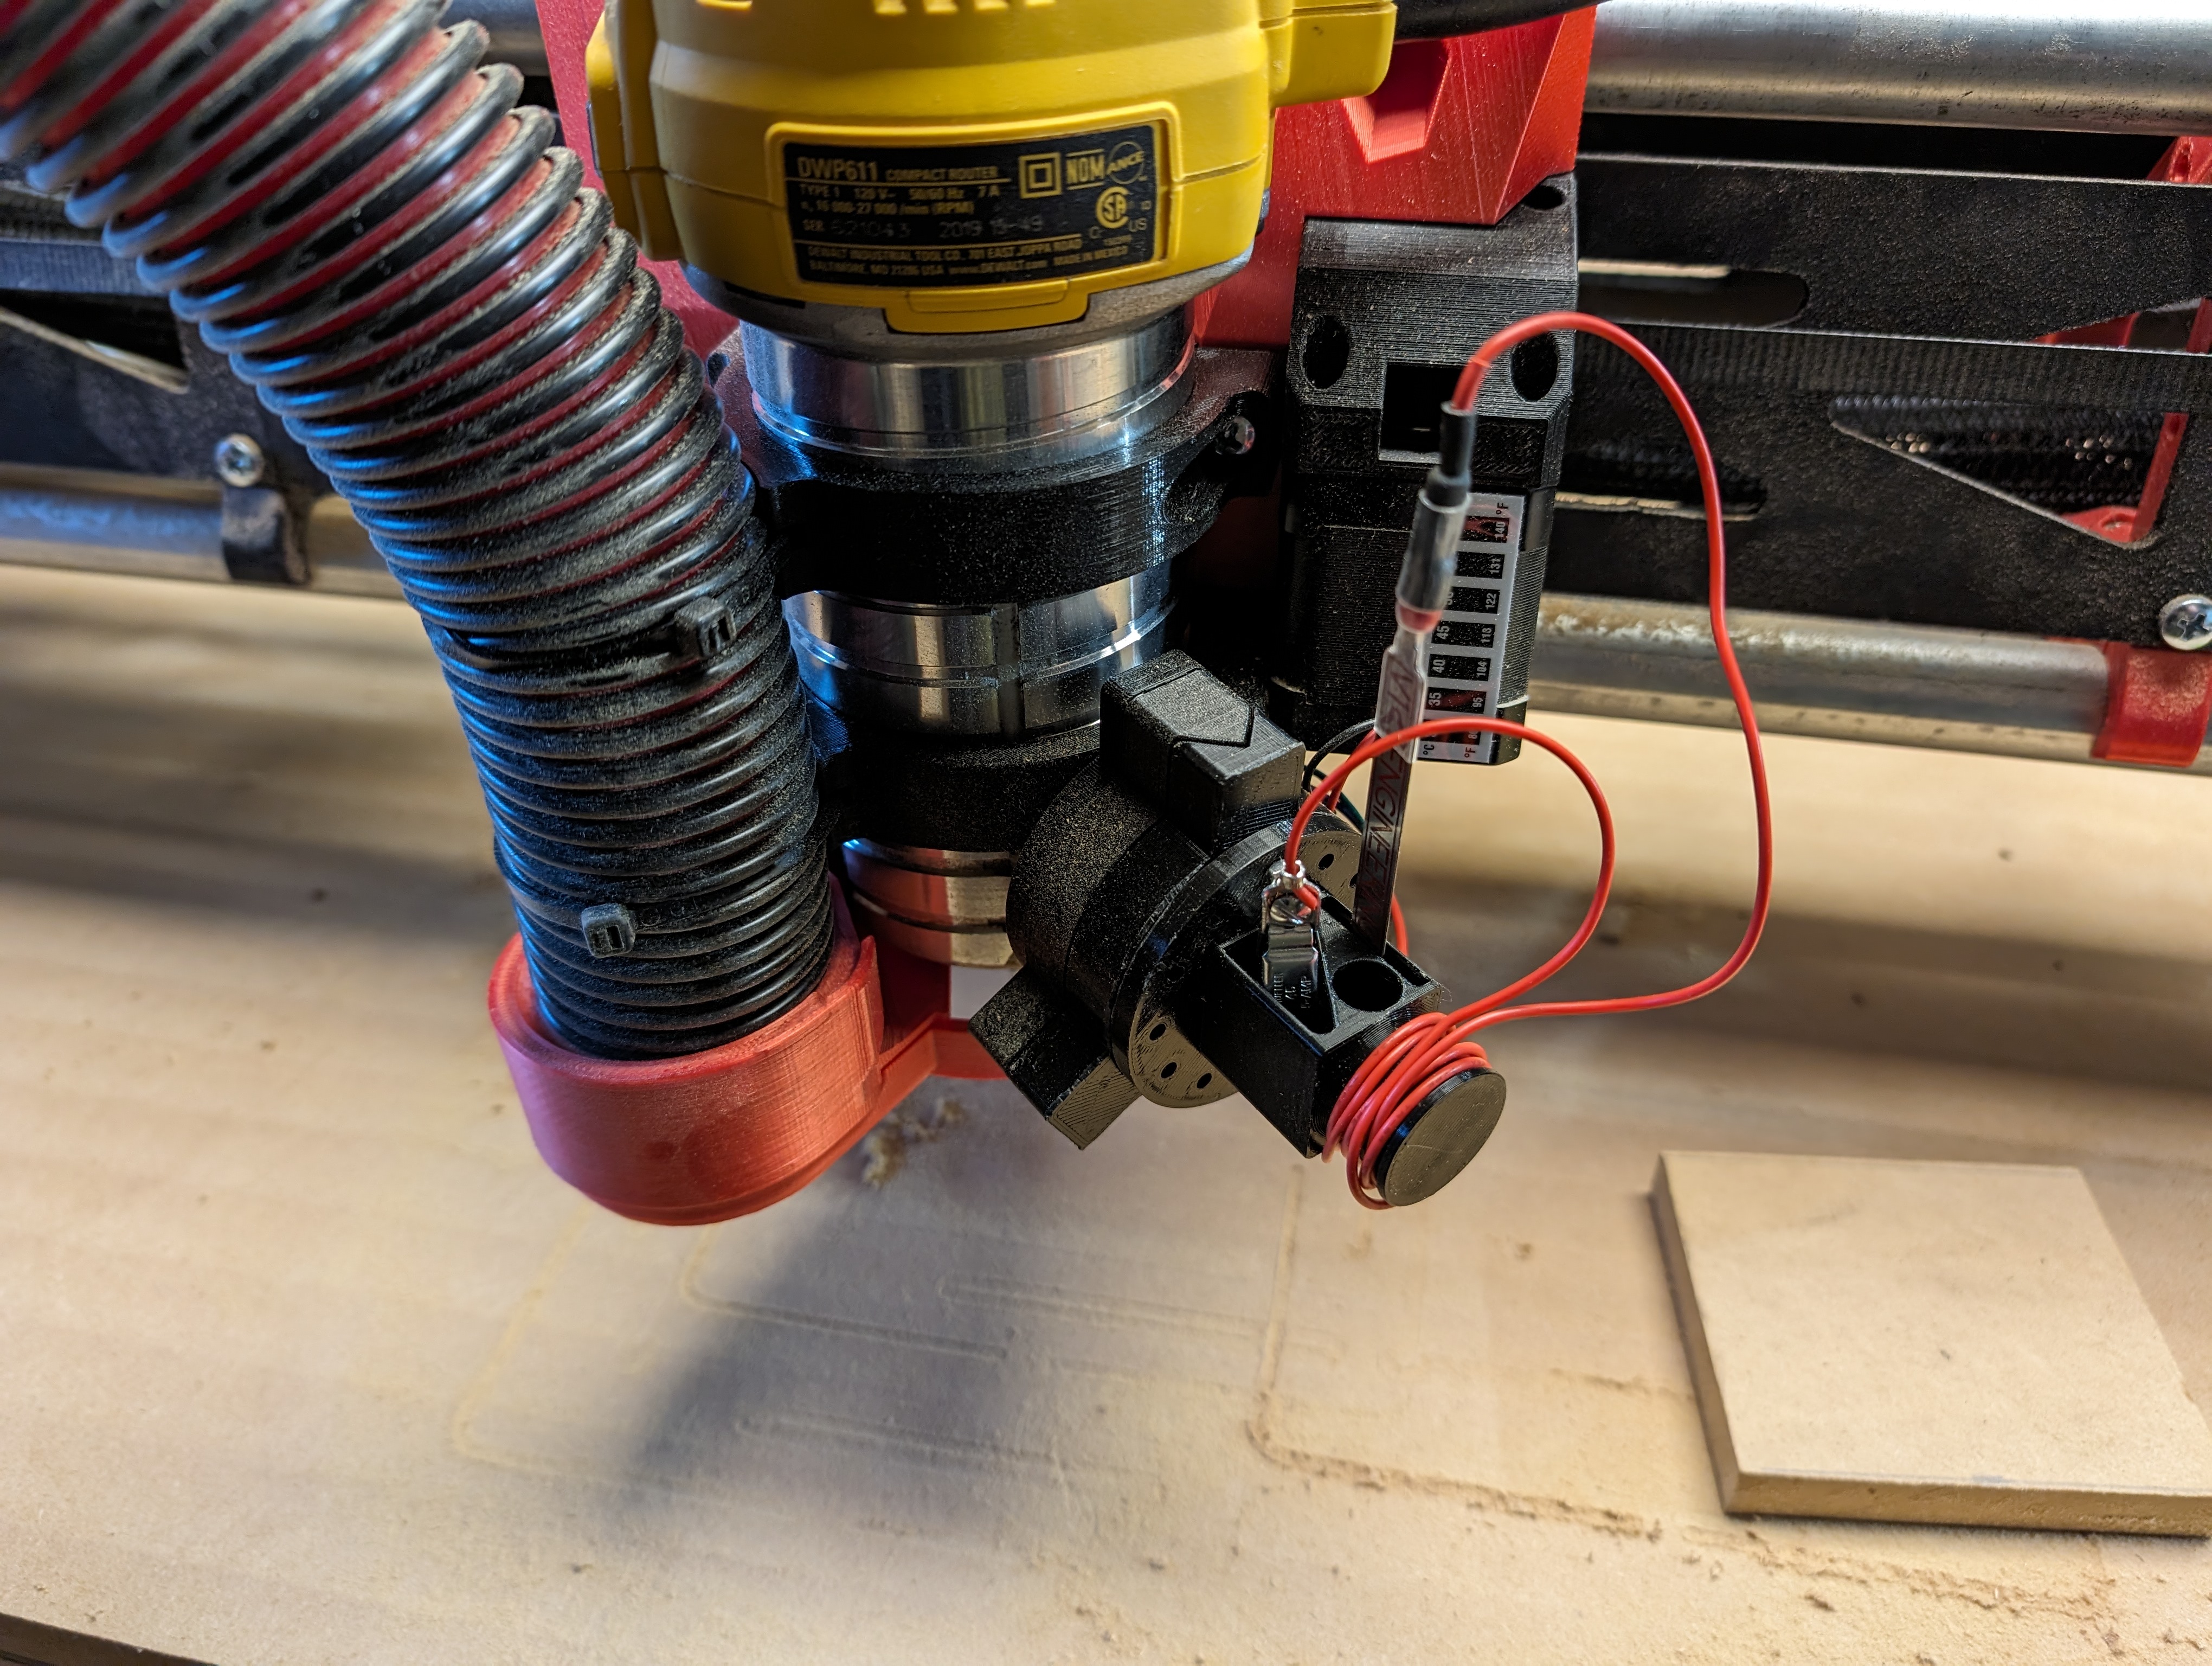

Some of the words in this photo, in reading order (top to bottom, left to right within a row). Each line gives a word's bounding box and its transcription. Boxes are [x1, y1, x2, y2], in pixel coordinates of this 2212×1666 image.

[798, 156, 878, 181] DWP611
[885, 168, 946, 182] COMPACT
[948, 165, 998, 180] ROUTER
[1066, 153, 1105, 184] NOM
[1106, 150, 1145, 176] ANCE
[799, 184, 831, 198] TYPE
[978, 185, 987, 198] 7
[988, 185, 1001, 197] A
[1128, 218, 1147, 232] US
[915, 250, 942, 261] TOOL
[987, 246, 1015, 259] EAST
[1016, 242, 1051, 257] JOPPA
[1053, 238, 1082, 253] ROAD
[1094, 245, 1129, 259] MEXICO
[1494, 521, 1506, 539] 140
[1490, 558, 1502, 574] 131
[1485, 593, 1497, 610] 122
[1436, 625, 1450, 640] 45
[1481, 627, 1493, 644] 113
[1432, 659, 1446, 674] 40
[1477, 661, 1488, 677] 104
[1429, 692, 1442, 706] 35
[1471, 697, 1483, 707] 95
[1274, 972, 1283, 1002] UELLER
